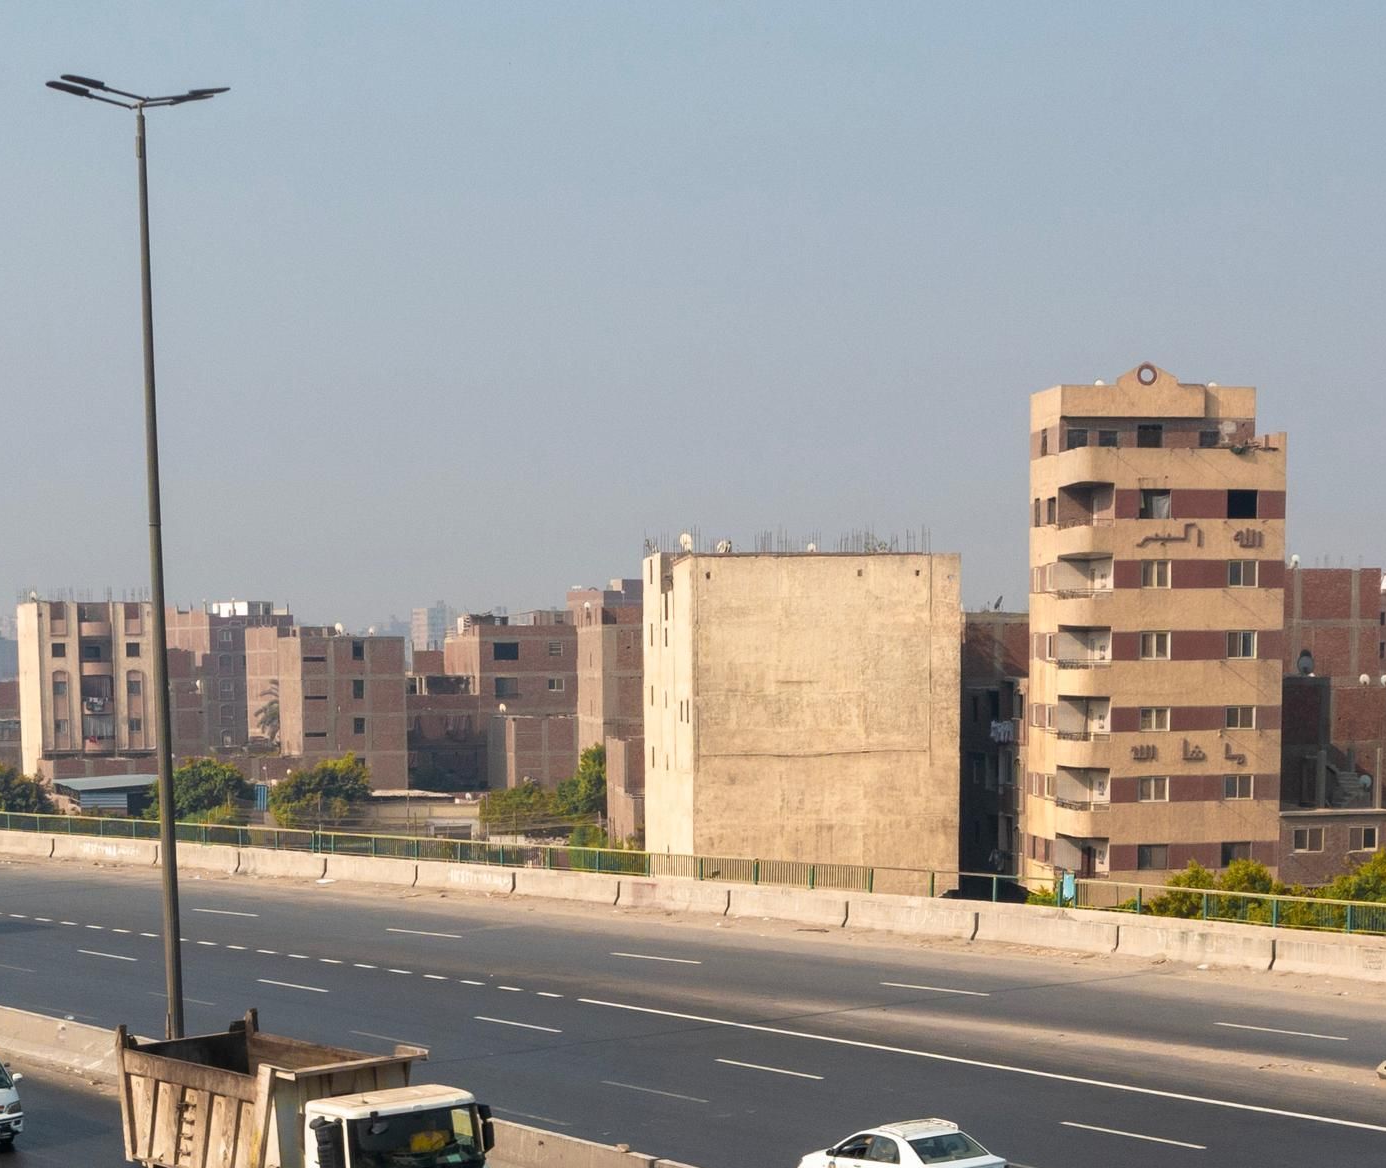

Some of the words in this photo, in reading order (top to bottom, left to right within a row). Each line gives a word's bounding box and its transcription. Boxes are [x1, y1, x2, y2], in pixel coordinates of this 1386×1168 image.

[1233, 528, 1263, 548] الله
[1131, 744, 1157, 761] الله
[1224, 742, 1246, 765] ما
